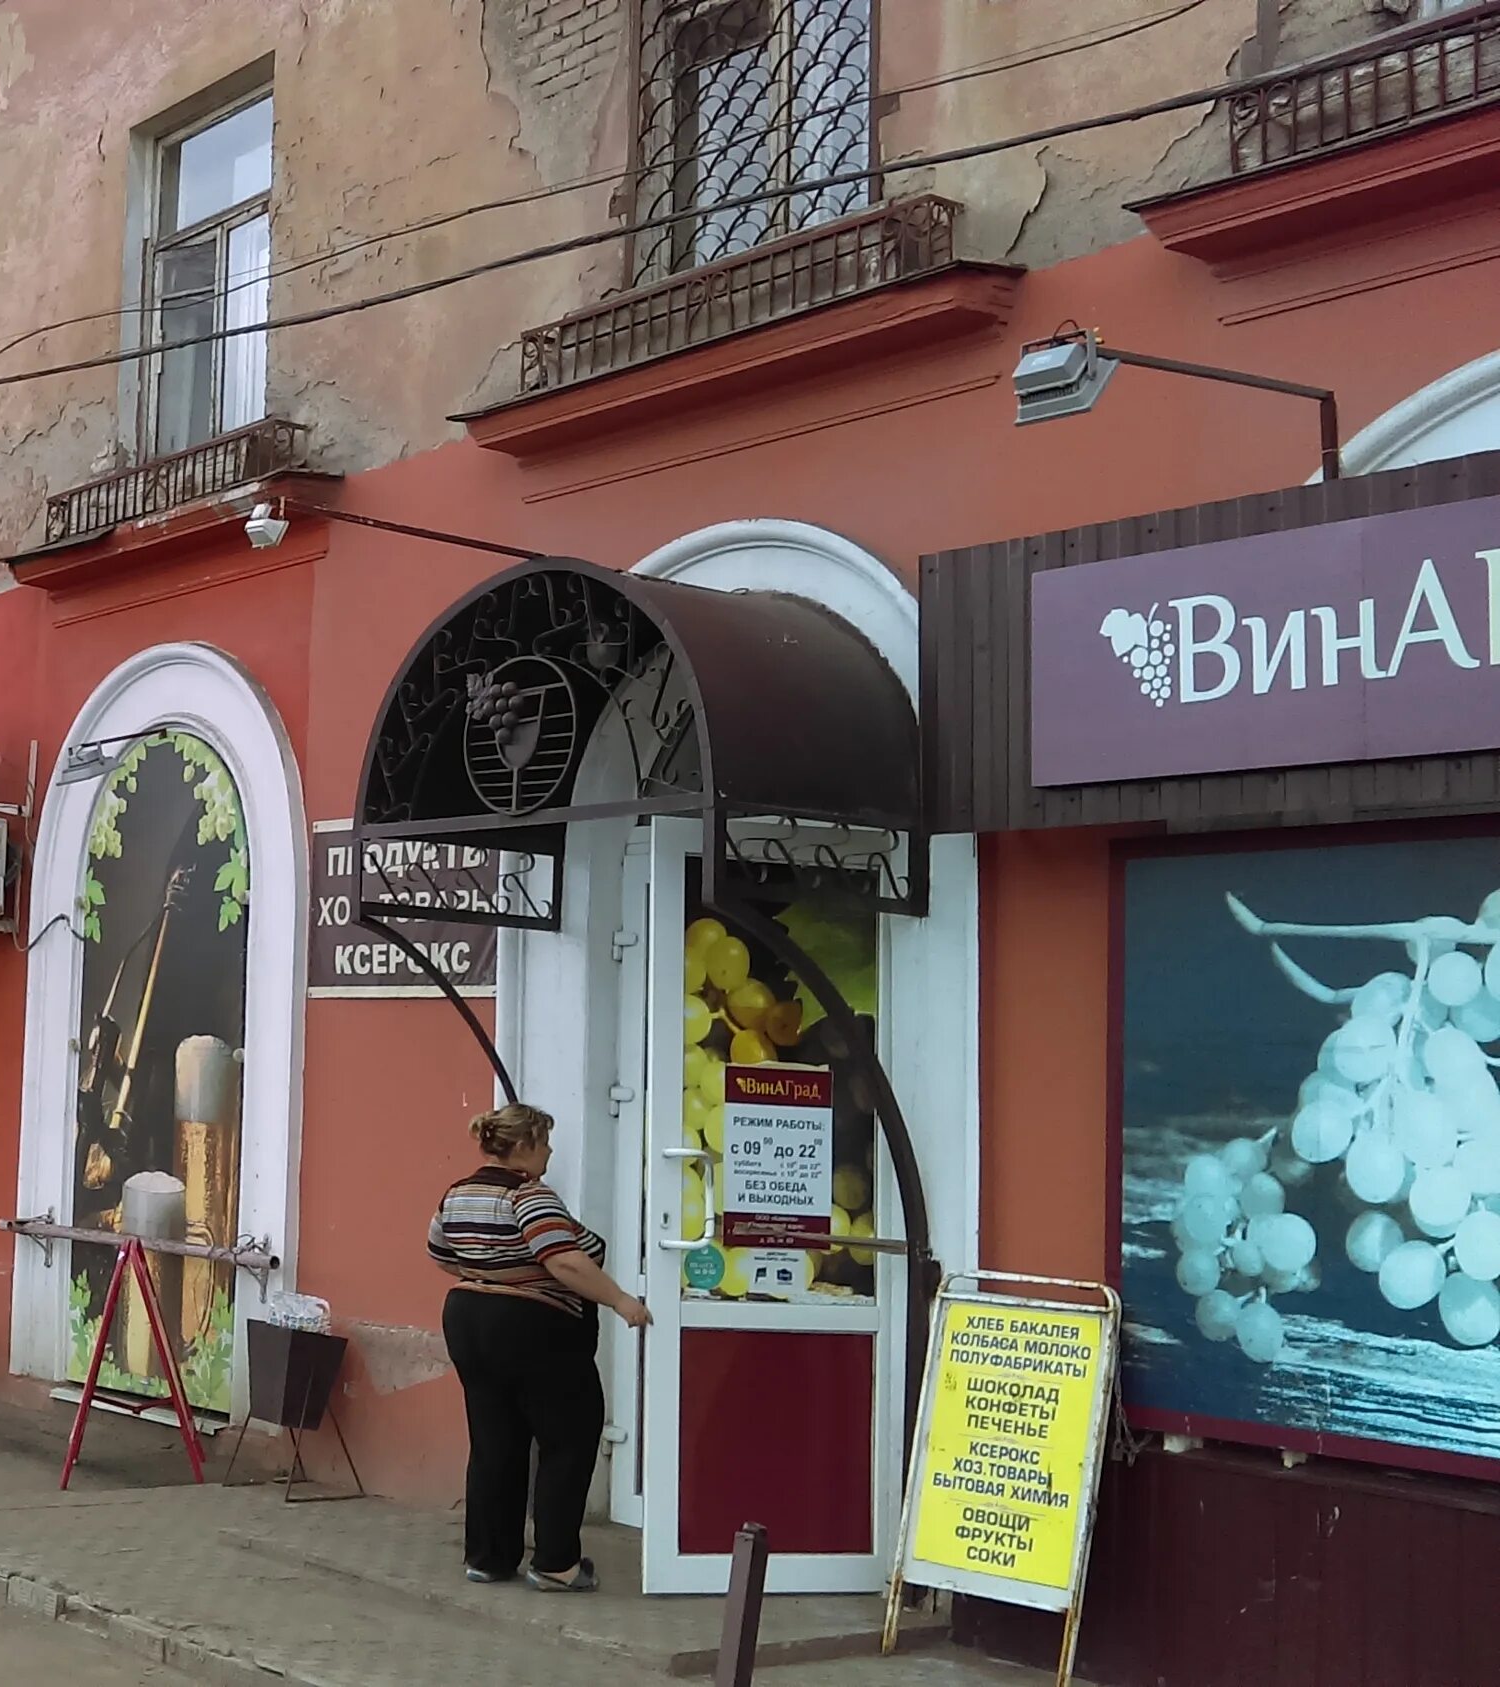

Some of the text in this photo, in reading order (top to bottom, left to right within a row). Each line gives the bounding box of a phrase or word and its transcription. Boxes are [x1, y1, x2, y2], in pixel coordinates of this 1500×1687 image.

[328, 841, 489, 877] ПОДУКТЫ
[317, 895, 364, 926] ХО
[335, 941, 471, 975] КСЕРОКС
[746, 1077, 821, 1100] ВинАГрад
[733, 1116, 773, 1128] РЕЖИМ
[774, 1146, 794, 1159] до
[745, 1180, 807, 1192] БЕЗ ОБЕДА
[738, 1193, 814, 1205] И ВЫХОДНЫХ
[966, 1316, 1079, 1340] ХЛЕБ БАКАЛЕЯ
[950, 1331, 1091, 1360] КОЛБАСА МОЛОКО
[950, 1349, 1087, 1378] ПОЛУФАБРИКАТЫ
[967, 1377, 1060, 1405] ШОКОЛАД
[965, 1395, 1056, 1421] КОНФЕТЫ
[967, 1414, 1048, 1439] ПЕЧЕНЬЕ
[969, 1442, 1040, 1465] КСЕРОКС
[933, 1472, 1069, 1508] БЫТОВАЯ ХИМИЯ
[962, 1507, 1030, 1532] ОВОЩИ
[955, 1526, 1033, 1552] ФРУКТЫ
[967, 1546, 1016, 1568] СОКИ
